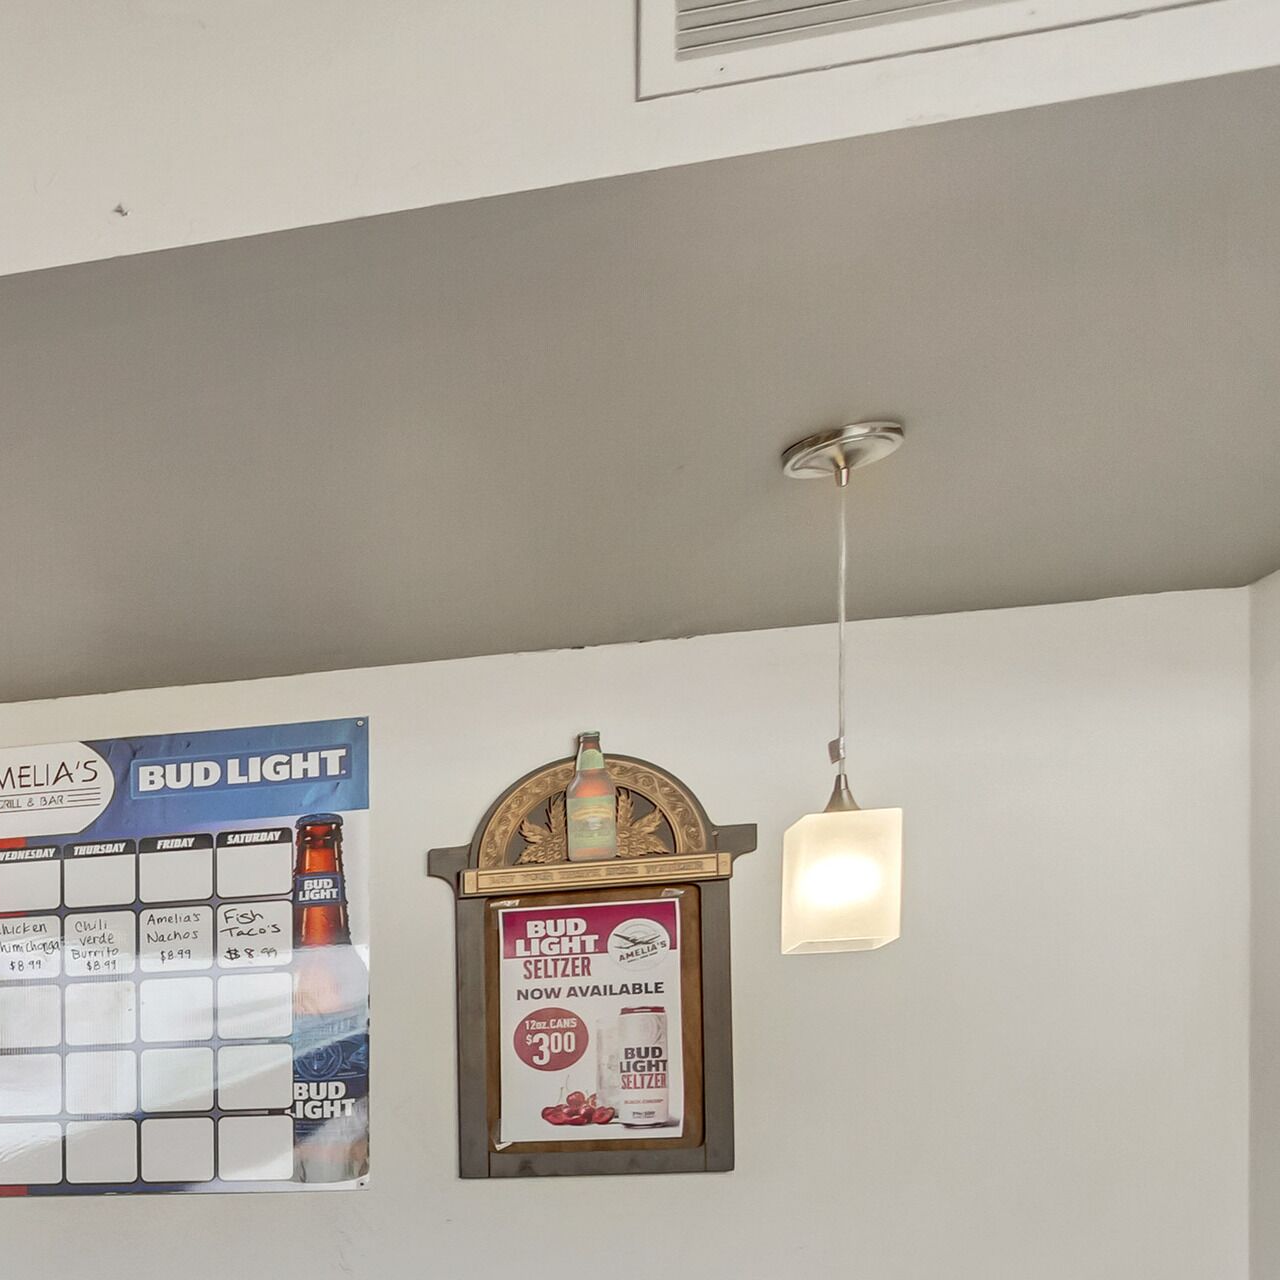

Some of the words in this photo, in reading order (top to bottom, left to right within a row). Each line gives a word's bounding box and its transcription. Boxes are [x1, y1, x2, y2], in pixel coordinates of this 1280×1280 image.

[138, 760, 222, 792] BUD
[227, 749, 347, 785] LIGHT
[40, 795, 64, 806] BAR
[73, 842, 126, 856] THURSDAY
[156, 837, 195, 849] FRIDAY
[226, 831, 282, 845] SATURDAY
[303, 878, 334, 890] BUD
[298, 888, 340, 901] LIGHT
[146, 913, 200, 926] Amelia's
[223, 908, 264, 925] Fish
[74, 919, 108, 933] Chili
[219, 924, 281, 937] Taco's
[526, 917, 587, 938] BUD
[146, 930, 199, 944] Nachos
[516, 934, 598, 956] LIGHT
[618, 939, 667, 963] AMELIA'S
[71, 947, 119, 960] Burrito
[523, 956, 591, 980] SELTZER
[516, 987, 562, 1001] NOW
[566, 981, 665, 998] AVAILABLE
[549, 1018, 577, 1029] CANS
[624, 1046, 663, 1060] BUD
[620, 1059, 668, 1073] LIGHT
[621, 1072, 667, 1090] SELTZER
[293, 1081, 346, 1100] BUD
